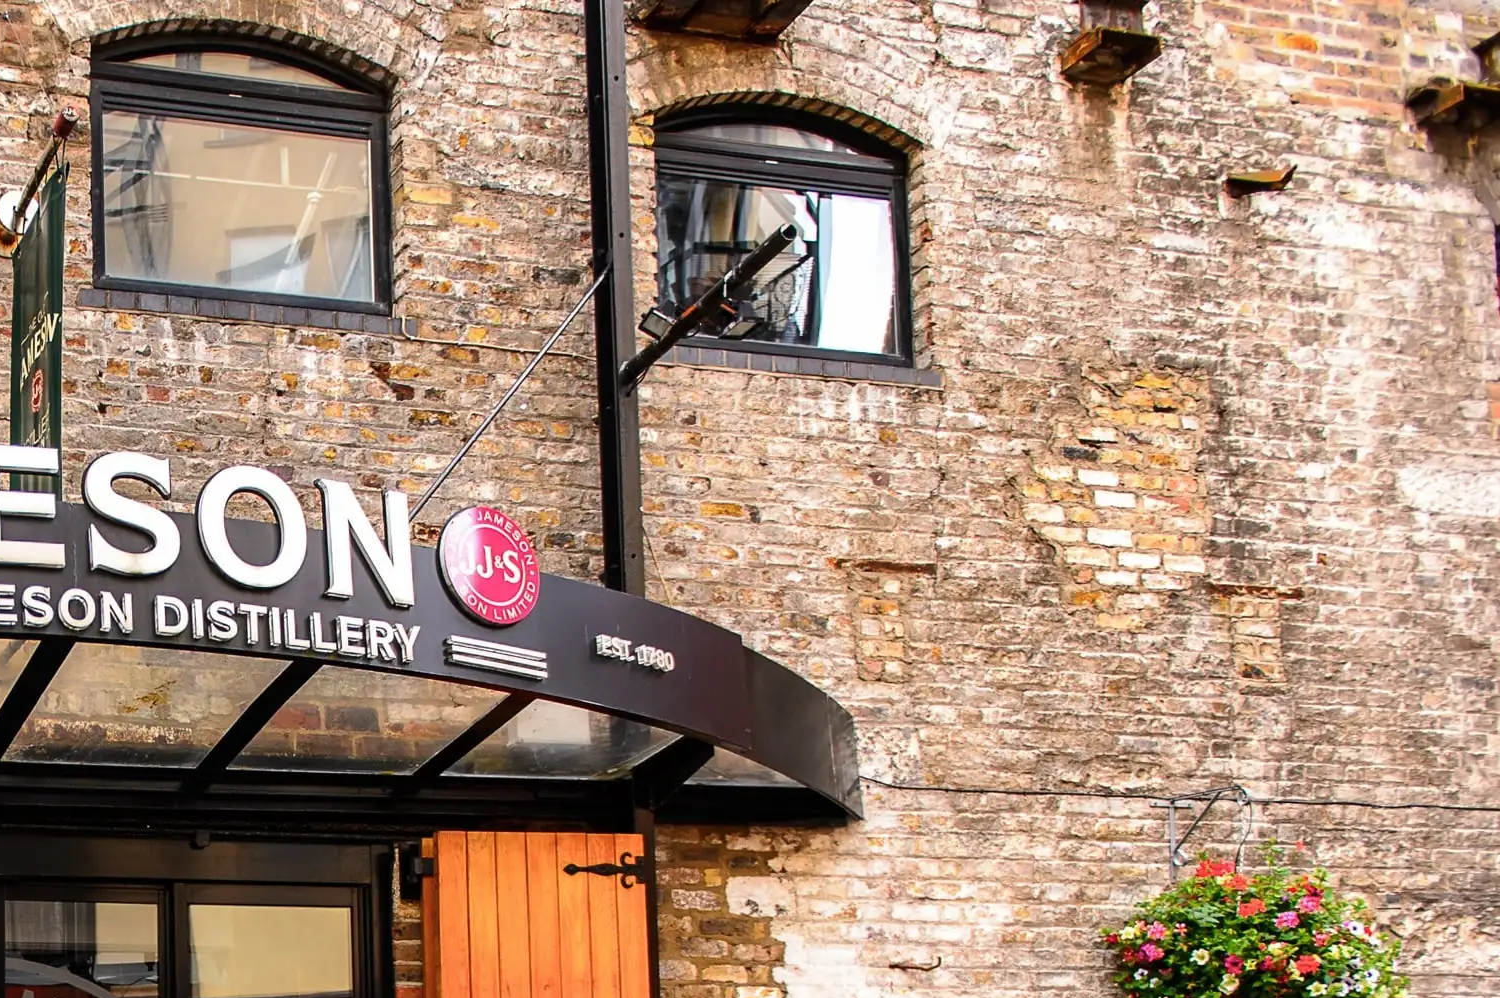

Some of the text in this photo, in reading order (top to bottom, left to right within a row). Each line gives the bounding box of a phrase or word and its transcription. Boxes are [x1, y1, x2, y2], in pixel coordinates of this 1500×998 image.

[477, 511, 535, 565] JAMESON
[494, 581, 536, 620] LIMITED
[154, 594, 421, 664] DISTILLERY
[635, 643, 676, 673] 1780
